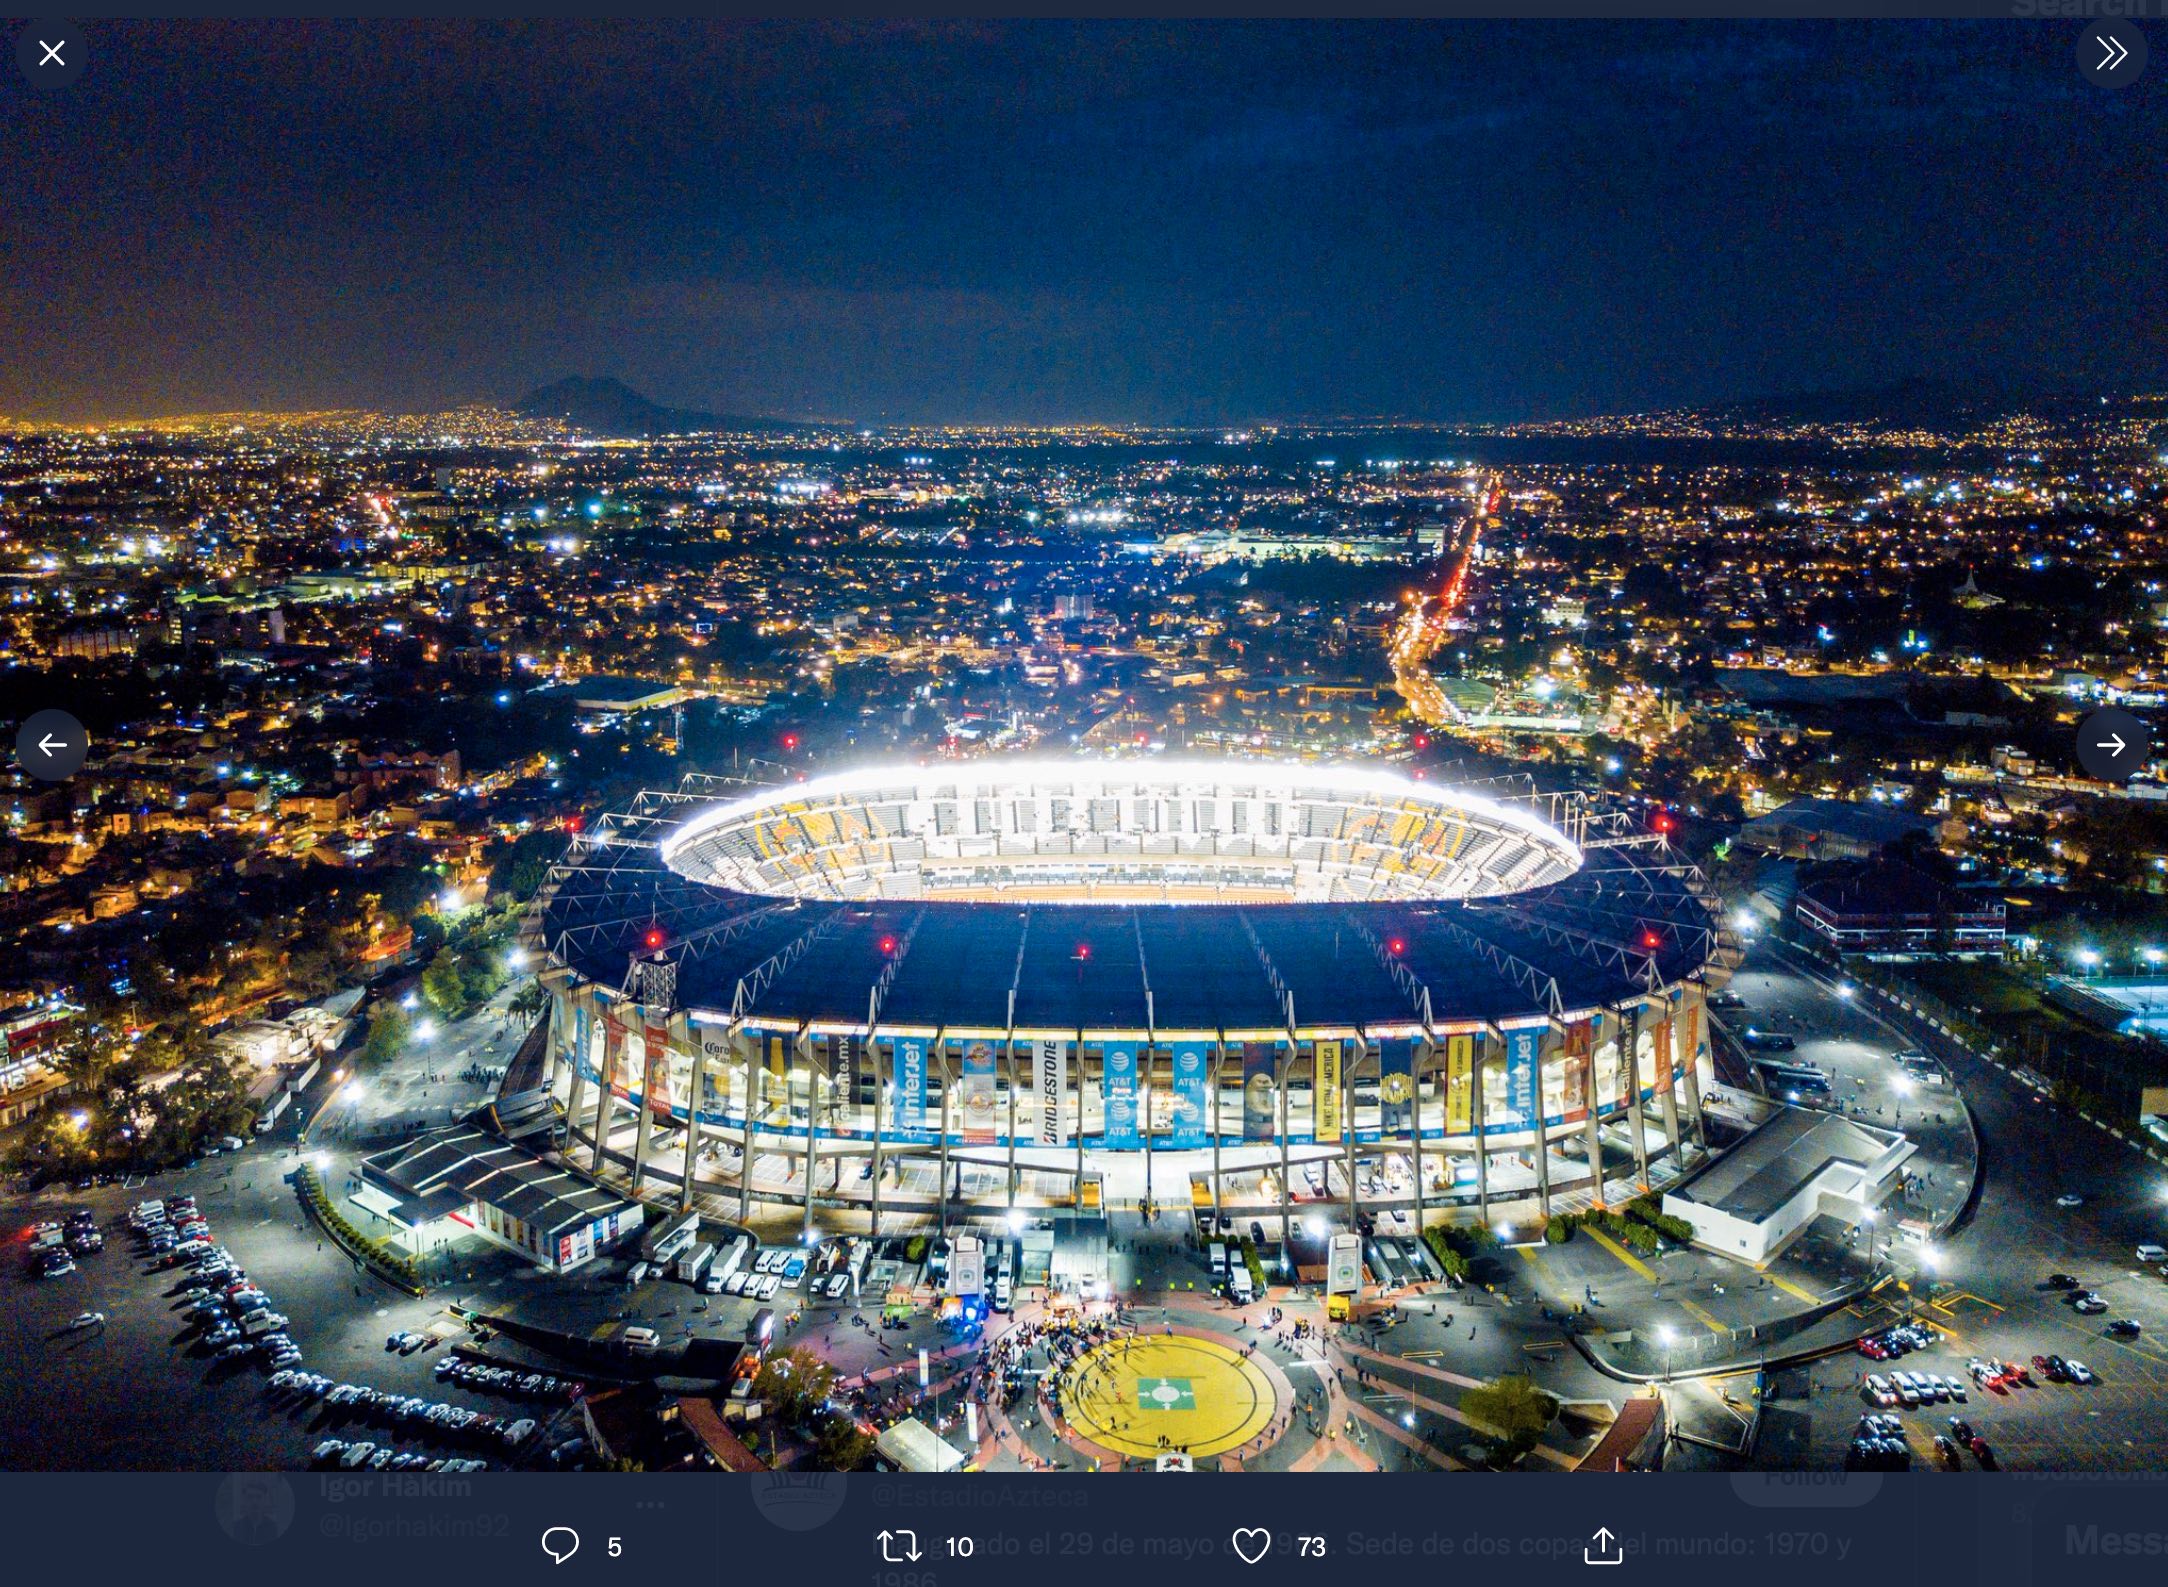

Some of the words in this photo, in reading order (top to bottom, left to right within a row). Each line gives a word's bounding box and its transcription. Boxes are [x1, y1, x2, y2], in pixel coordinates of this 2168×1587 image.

[837, 1036, 850, 1121] caliente.mx
[1108, 1077, 1132, 1087] AT&T
[1177, 1077, 1201, 1087] AT&T
[1043, 1040, 1057, 1145] BRIDGESTONE
[649, 1100, 670, 1111] TOTAL
[1108, 1127, 1133, 1136] AT&T
[1177, 1127, 1201, 1137] AT&T
